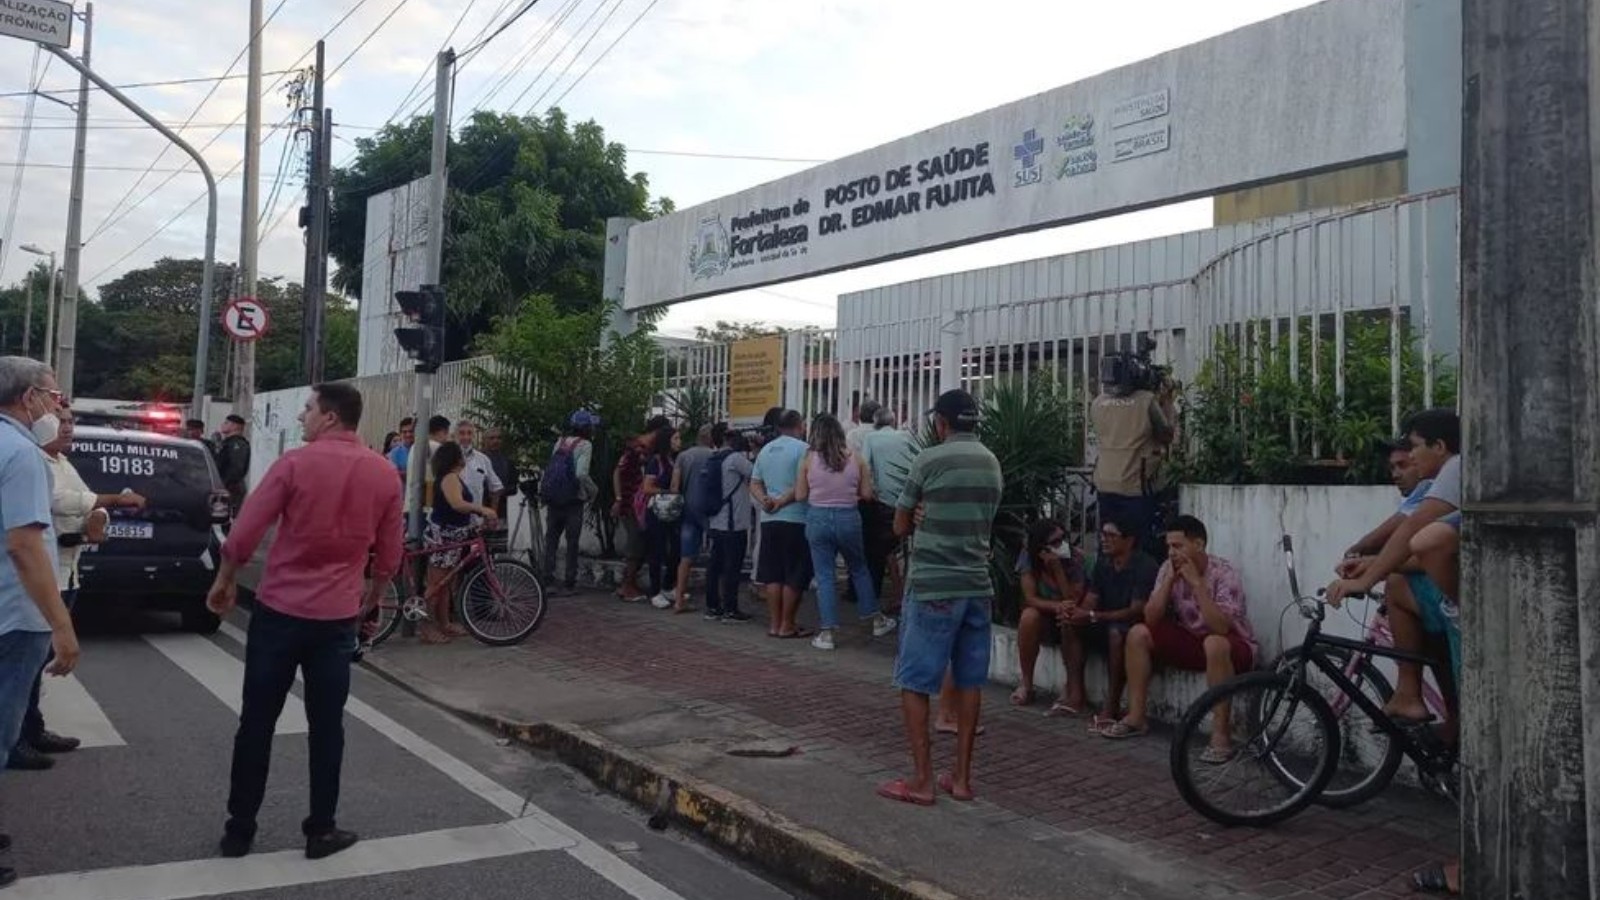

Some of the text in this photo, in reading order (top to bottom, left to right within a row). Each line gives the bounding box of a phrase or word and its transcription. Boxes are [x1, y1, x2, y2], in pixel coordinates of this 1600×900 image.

[1133, 136, 1165, 150] BRASIL
[824, 142, 989, 208] POSTO DE SAÚDE
[1015, 168, 1040, 184] SUS
[819, 172, 996, 236] DR. EDMAR FUJITA
[731, 206, 791, 232] Prefeitura
[730, 223, 809, 258] Fortaleza
[237, 306, 255, 331] E
[71, 441, 178, 460] POLÍCIA MILITAR
[100, 456, 155, 476] 19183
